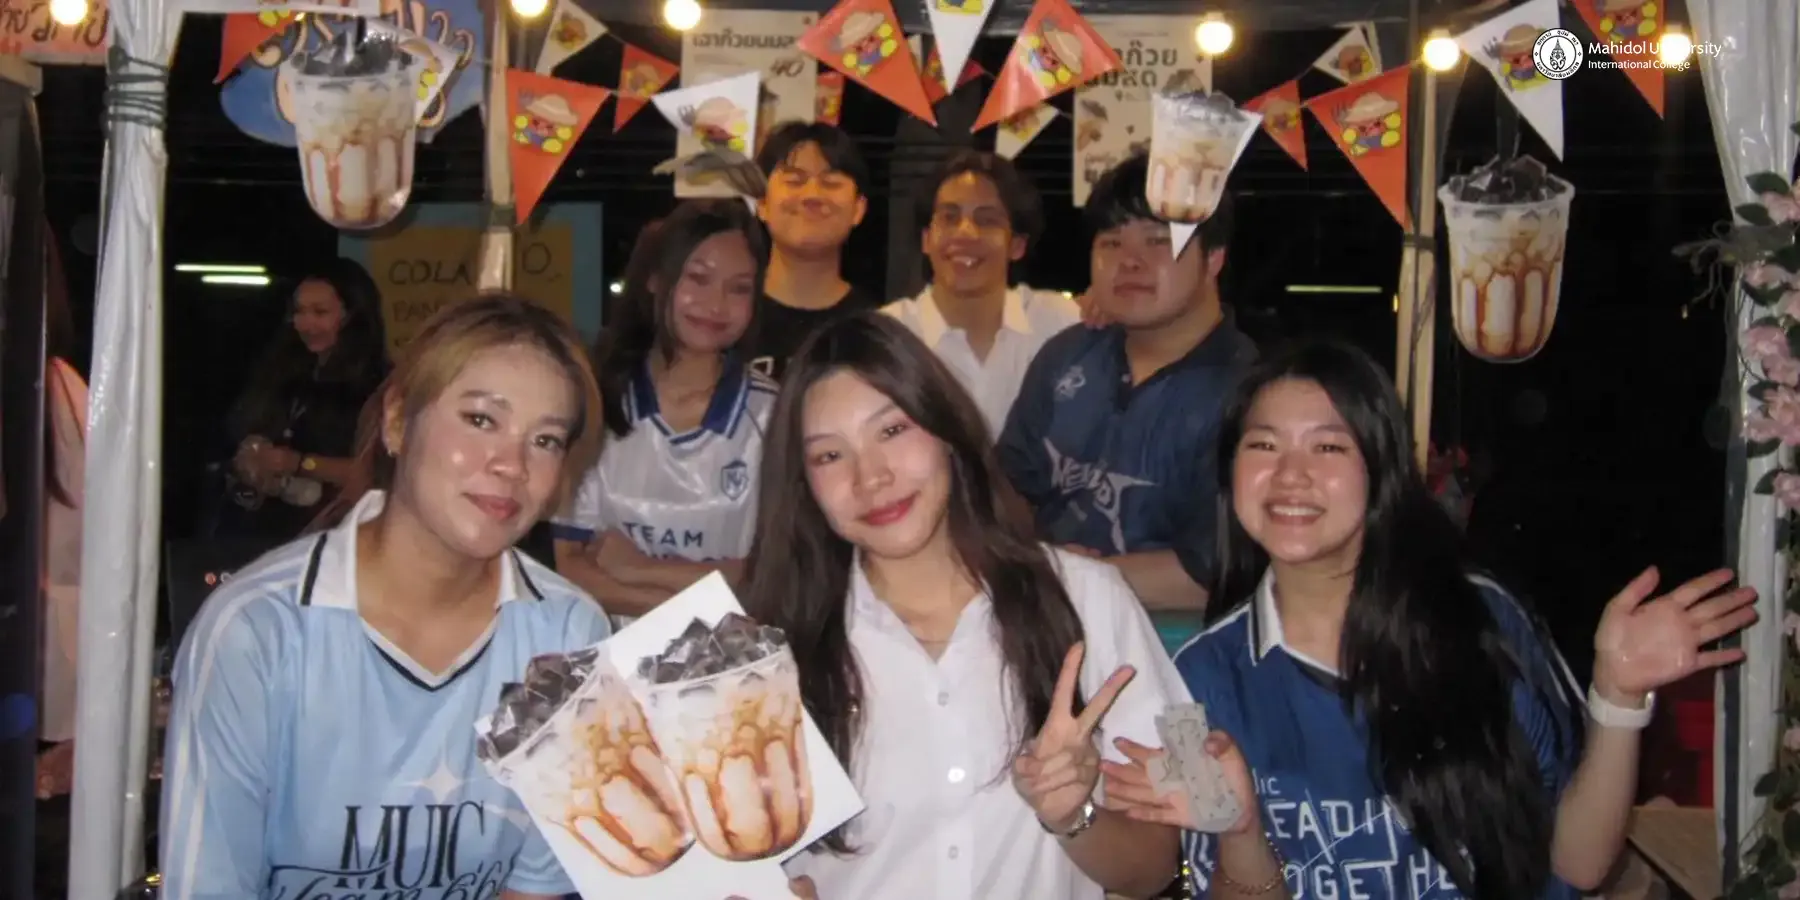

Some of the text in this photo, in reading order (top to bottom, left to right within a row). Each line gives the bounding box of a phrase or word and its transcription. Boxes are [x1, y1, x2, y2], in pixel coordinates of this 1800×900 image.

[693, 27, 797, 48] เฉาก๊วยนมส
[388, 258, 473, 286] COLA
[621, 521, 704, 548] TEAM
[333, 800, 485, 890] MUIC
